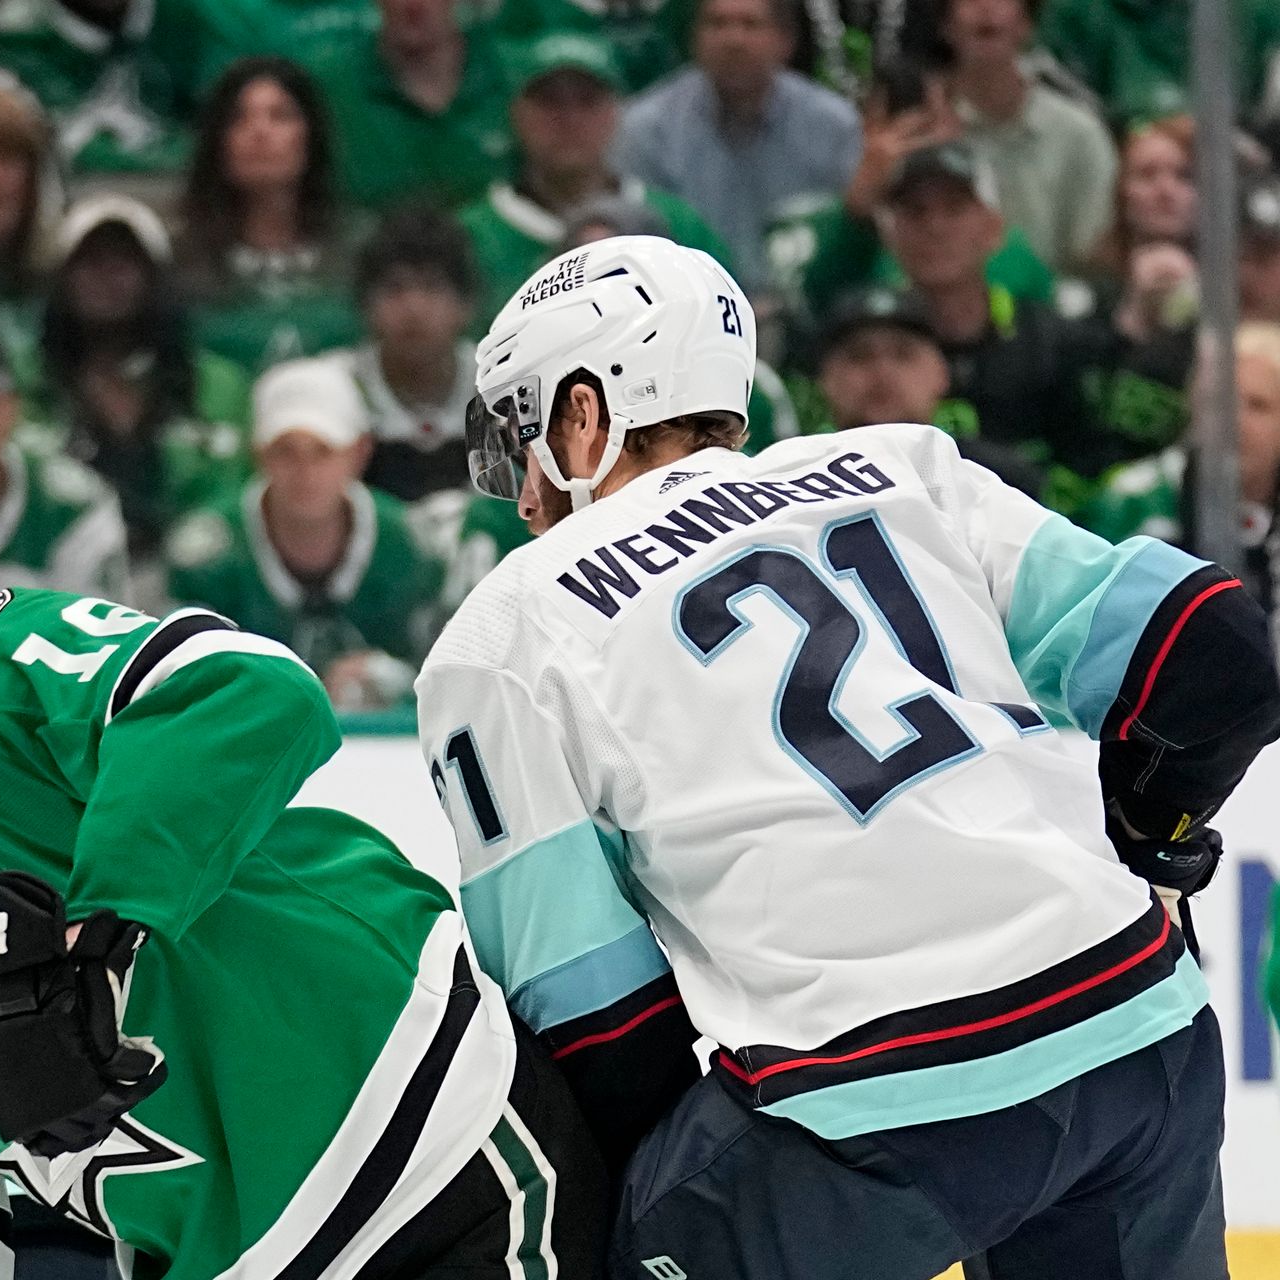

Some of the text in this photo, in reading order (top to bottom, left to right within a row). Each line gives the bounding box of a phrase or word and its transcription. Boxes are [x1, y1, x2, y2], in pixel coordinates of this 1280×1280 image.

[520, 262, 586, 300] LIMATE
[718, 295, 743, 338] 21
[556, 453, 896, 620] WENNBERG
[11, 598, 161, 683] 16
[672, 509, 1054, 830] 21
